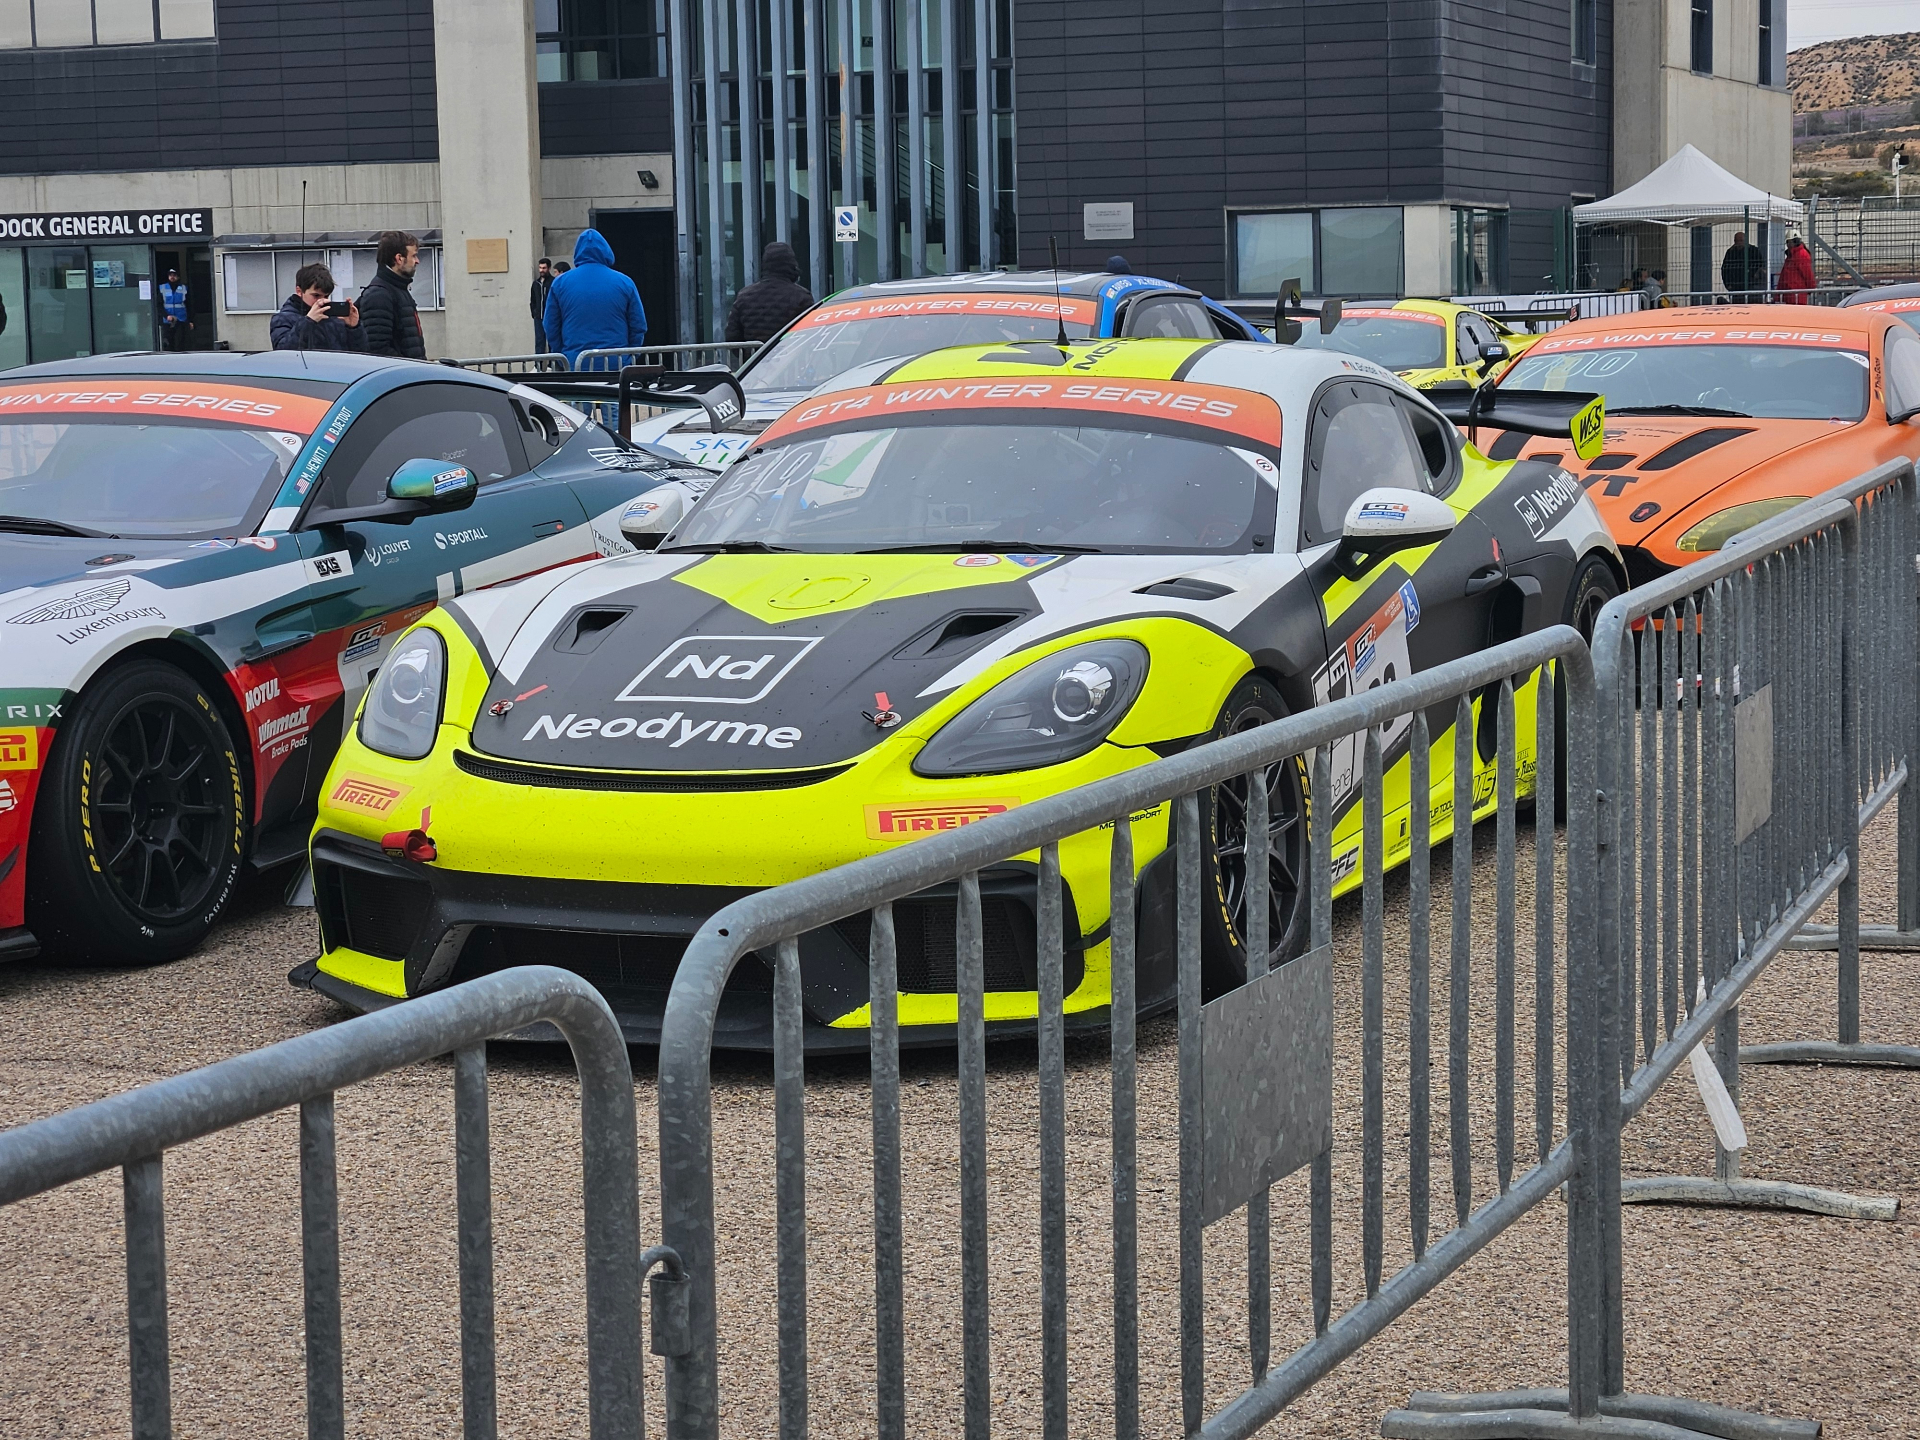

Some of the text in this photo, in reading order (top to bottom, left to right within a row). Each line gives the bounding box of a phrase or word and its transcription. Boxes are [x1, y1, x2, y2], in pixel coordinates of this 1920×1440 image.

[50, 214, 134, 236] GENERAL
[138, 213, 203, 234] OFFICE
[813, 300, 1078, 322] GT4 WINTER SERIES
[1379, 310, 1439, 322] SERIES
[1859, 303, 1886, 312] T4
[1543, 330, 1843, 350] GT4 WINTER SERIES
[131, 393, 283, 416] SERIES
[712, 398, 739, 419] HRX
[796, 383, 1239, 422] GT4 WINTER SERIES
[306, 446, 328, 473] HEWITT
[379, 539, 412, 555] LOUYET
[447, 527, 489, 546] SPORTALL
[52, 592, 106, 613] ASTON MARTIN
[56, 606, 166, 645] Luxembourg
[665, 653, 775, 682] Nd
[245, 678, 280, 713] MOTUL
[0, 704, 63, 719] RIX
[522, 711, 802, 749] Neodyme
[271, 734, 308, 759] Brake Pads
[81, 759, 95, 850] ZERO
[225, 750, 243, 855] PIRELLI
[332, 779, 400, 811] PIRELLI
[1098, 809, 1162, 831] MORSPORT
